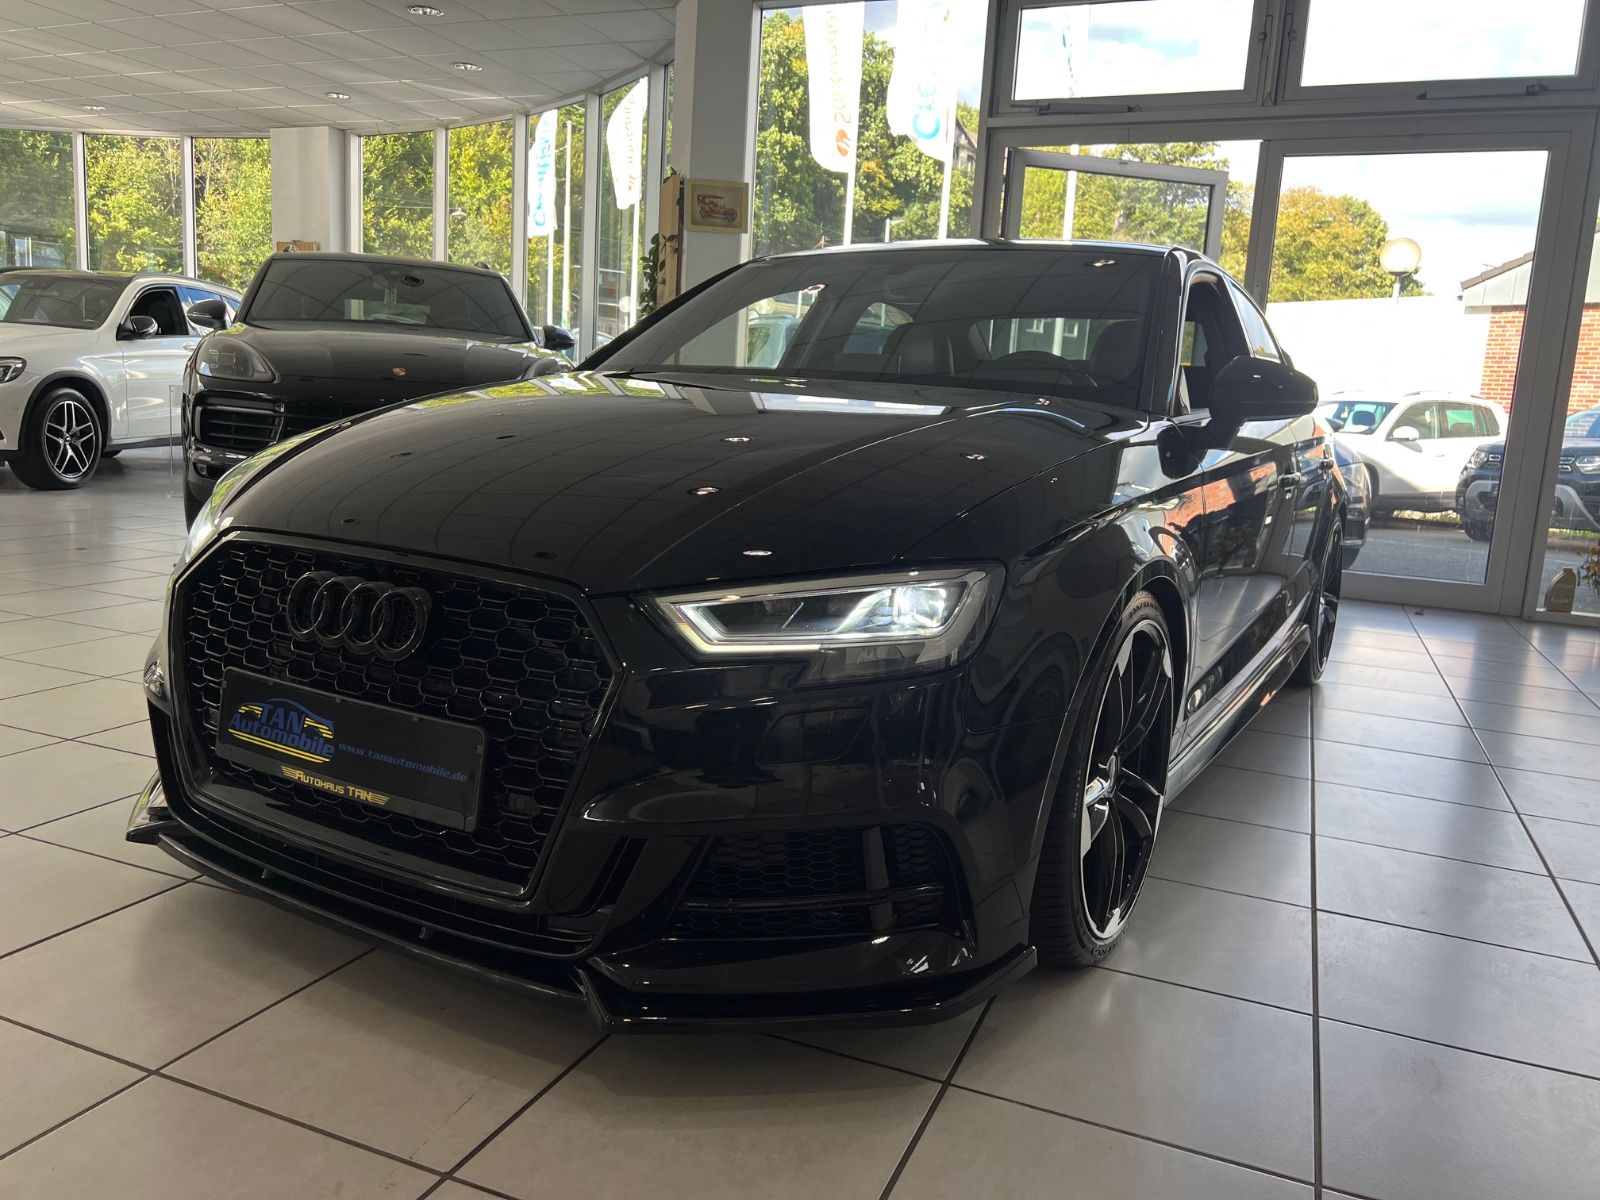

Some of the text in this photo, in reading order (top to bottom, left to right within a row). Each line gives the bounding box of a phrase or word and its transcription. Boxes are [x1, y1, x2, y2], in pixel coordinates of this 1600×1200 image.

[262, 703, 304, 733] TAN
[228, 713, 335, 759] Automobile
[338, 743, 468, 783] www.tanautomobile.de
[346, 785, 373, 803] TAN
